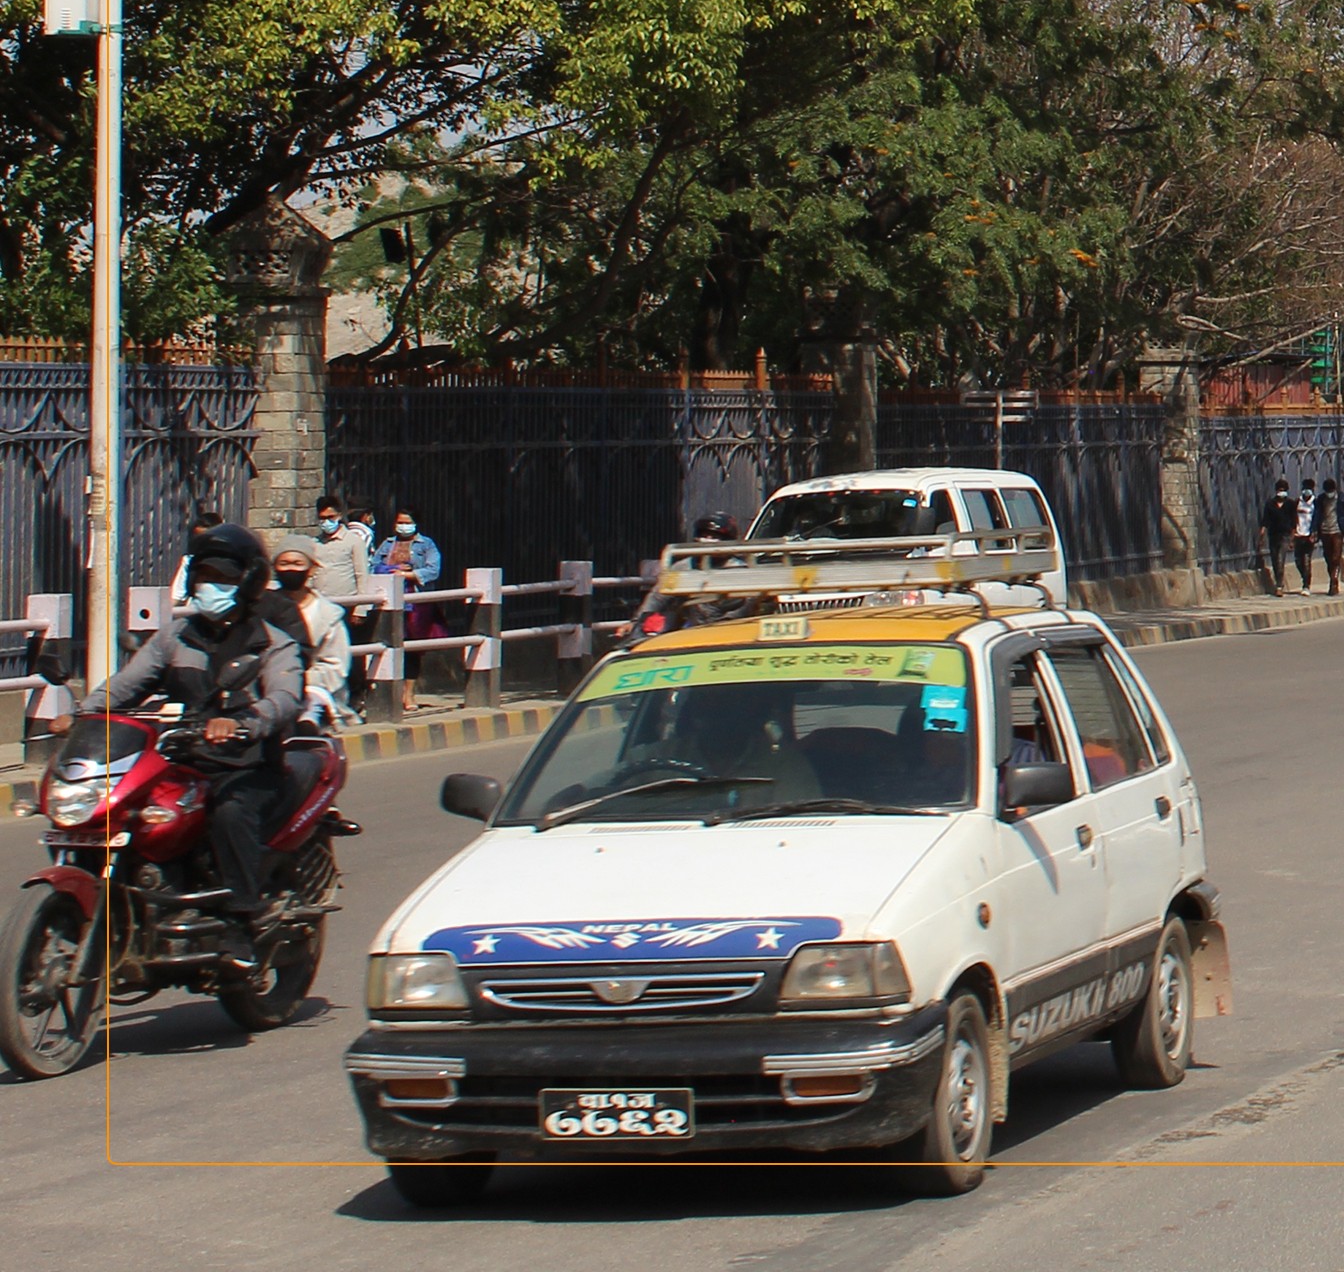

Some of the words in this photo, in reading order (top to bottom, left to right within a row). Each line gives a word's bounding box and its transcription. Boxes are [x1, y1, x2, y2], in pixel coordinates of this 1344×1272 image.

[763, 622, 799, 636] TAXI
[582, 923, 679, 934] NEPAL
[1107, 961, 1145, 1008] 800
